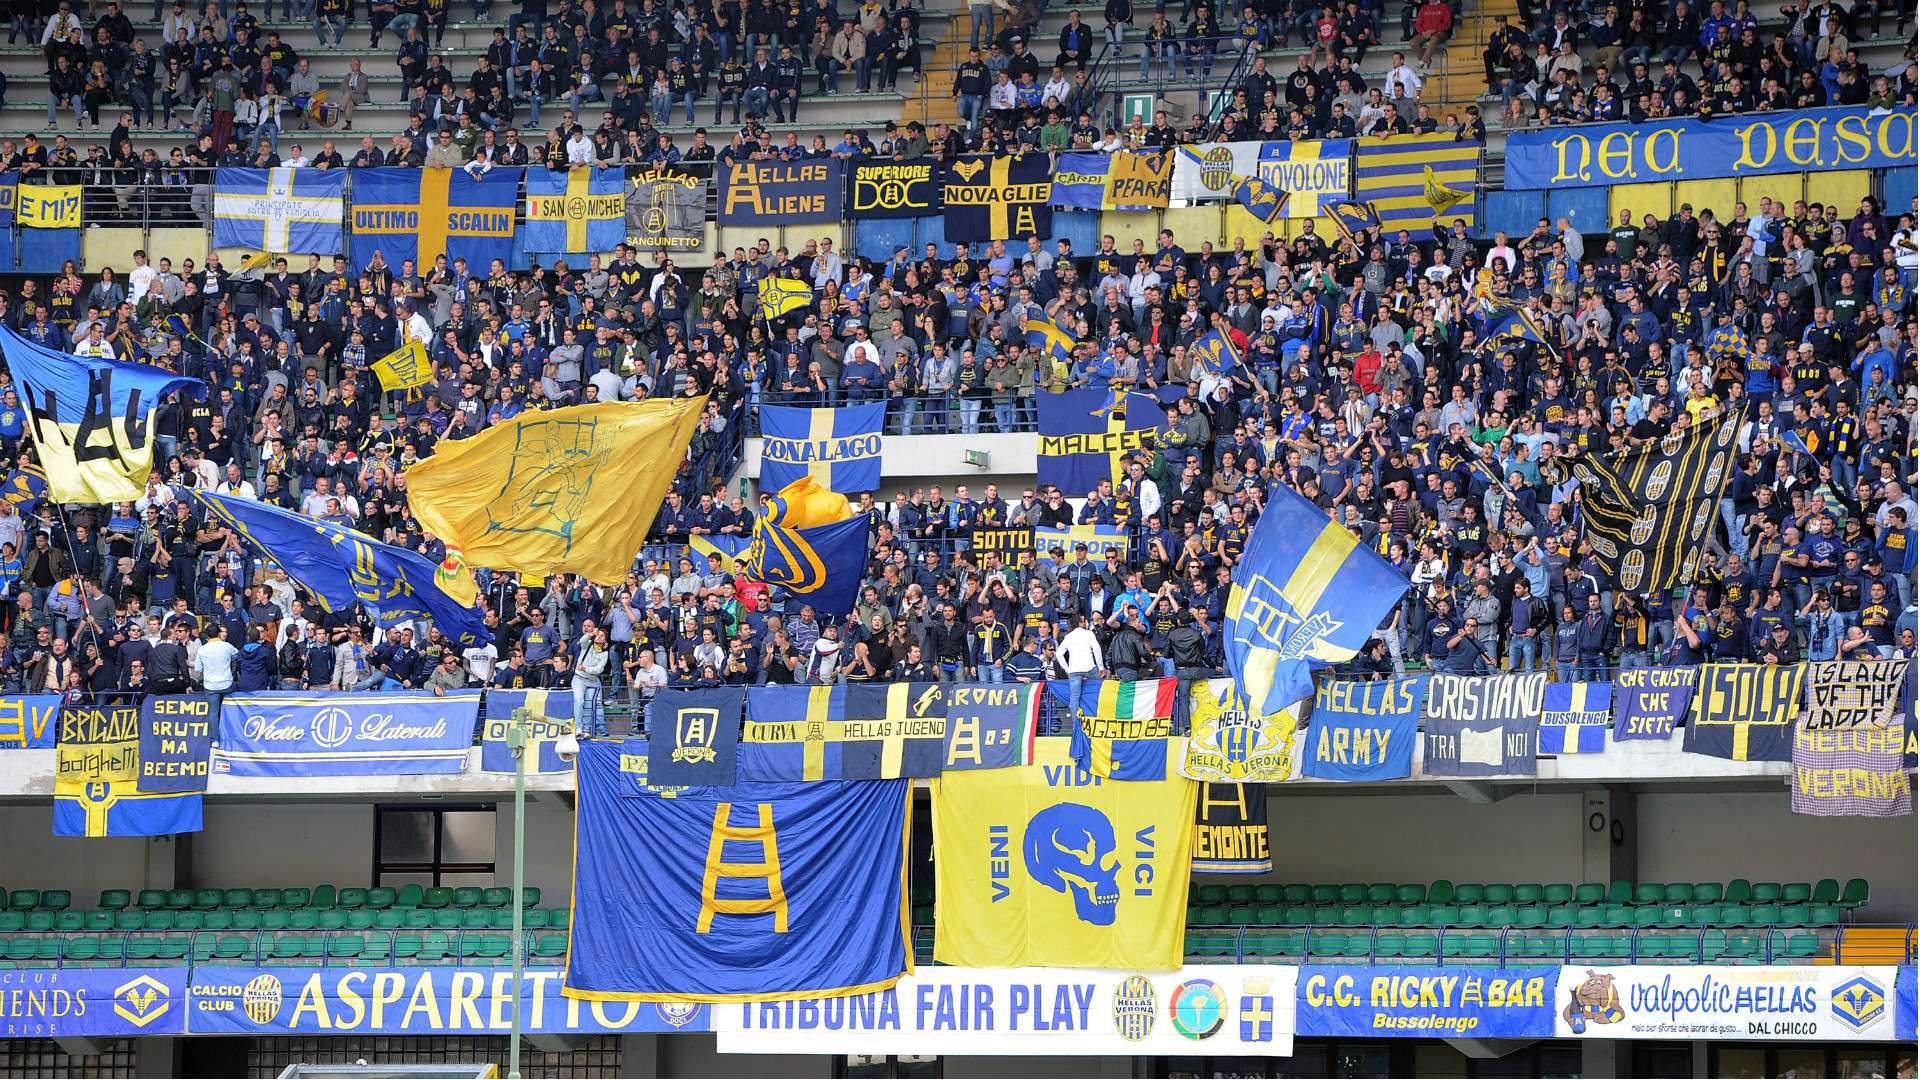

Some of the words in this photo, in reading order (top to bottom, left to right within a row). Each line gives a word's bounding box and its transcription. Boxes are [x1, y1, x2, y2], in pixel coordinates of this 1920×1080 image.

[631, 168, 698, 190] HELLAS
[729, 163, 827, 185] HELLAS
[856, 165, 931, 180] SUPERIORE
[725, 185, 826, 215] ALIENS
[854, 180, 930, 210] DOC
[945, 184, 1048, 203] NOVAGLIE
[21, 196, 35, 218] E
[543, 199, 565, 217] SAN
[355, 209, 418, 229] ULTIMO
[448, 212, 509, 232] SCALIN
[626, 237, 699, 247] SANGUINETTO
[972, 530, 1030, 549] SOTTO
[1619, 670, 1648, 688] CHE
[1650, 668, 1695, 687] GIUSTI
[1814, 661, 1908, 684] ISLAND
[947, 688, 1018, 706] RONA
[1316, 678, 1418, 715] HELLAS
[1426, 671, 1548, 721] CRISTIANO
[1639, 692, 1668, 712] CHE
[1701, 666, 1798, 722] ISOLA
[1815, 684, 1845, 707] OF
[154, 700, 209, 716] SEMO
[1544, 711, 1606, 725] BUSSOLENGO
[62, 708, 139, 742] BRIGATA
[152, 722, 208, 737] BRUTI
[243, 714, 305, 741] Viette
[355, 713, 448, 741] Laterali
[844, 721, 891, 738] HELLAS
[896, 720, 945, 737] JUGEND
[1082, 718, 1143, 739] AGGIO
[1145, 718, 1170, 737] 85
[1627, 715, 1674, 734] SIETE
[1806, 708, 1885, 730] LADDE
[751, 725, 796, 741] CURVA
[161, 740, 188, 754] MA
[676, 747, 712, 759] VERONA
[1316, 726, 1392, 764] ARMY
[1430, 734, 1456, 759] TRA
[1506, 733, 1528, 757] NOI
[60, 747, 136, 778] borghetti
[144, 761, 208, 777] BEEMO
[1190, 755, 1232, 774] HELLAS
[1242, 755, 1289, 775] VERONA
[1798, 767, 1909, 800] VERONA
[1192, 825, 1270, 859] IEMONTE
[989, 825, 1010, 904] VENI
[1135, 825, 1156, 897] VICI
[192, 985, 243, 996] CALCIO
[1305, 975, 1361, 1008] C.C.
[1370, 975, 1459, 1008] RICKY
[1487, 976, 1545, 1008] BAR
[199, 999, 235, 1012] CLUB
[916, 984, 995, 1031] FAIR
[1009, 984, 1096, 1031] PLAY
[1115, 1006, 1154, 1014] VERONA
[1372, 1013, 1478, 1033] Bussolengo
[1748, 1022, 1772, 1035] DAL
[1774, 1022, 1817, 1035] CHICCO
